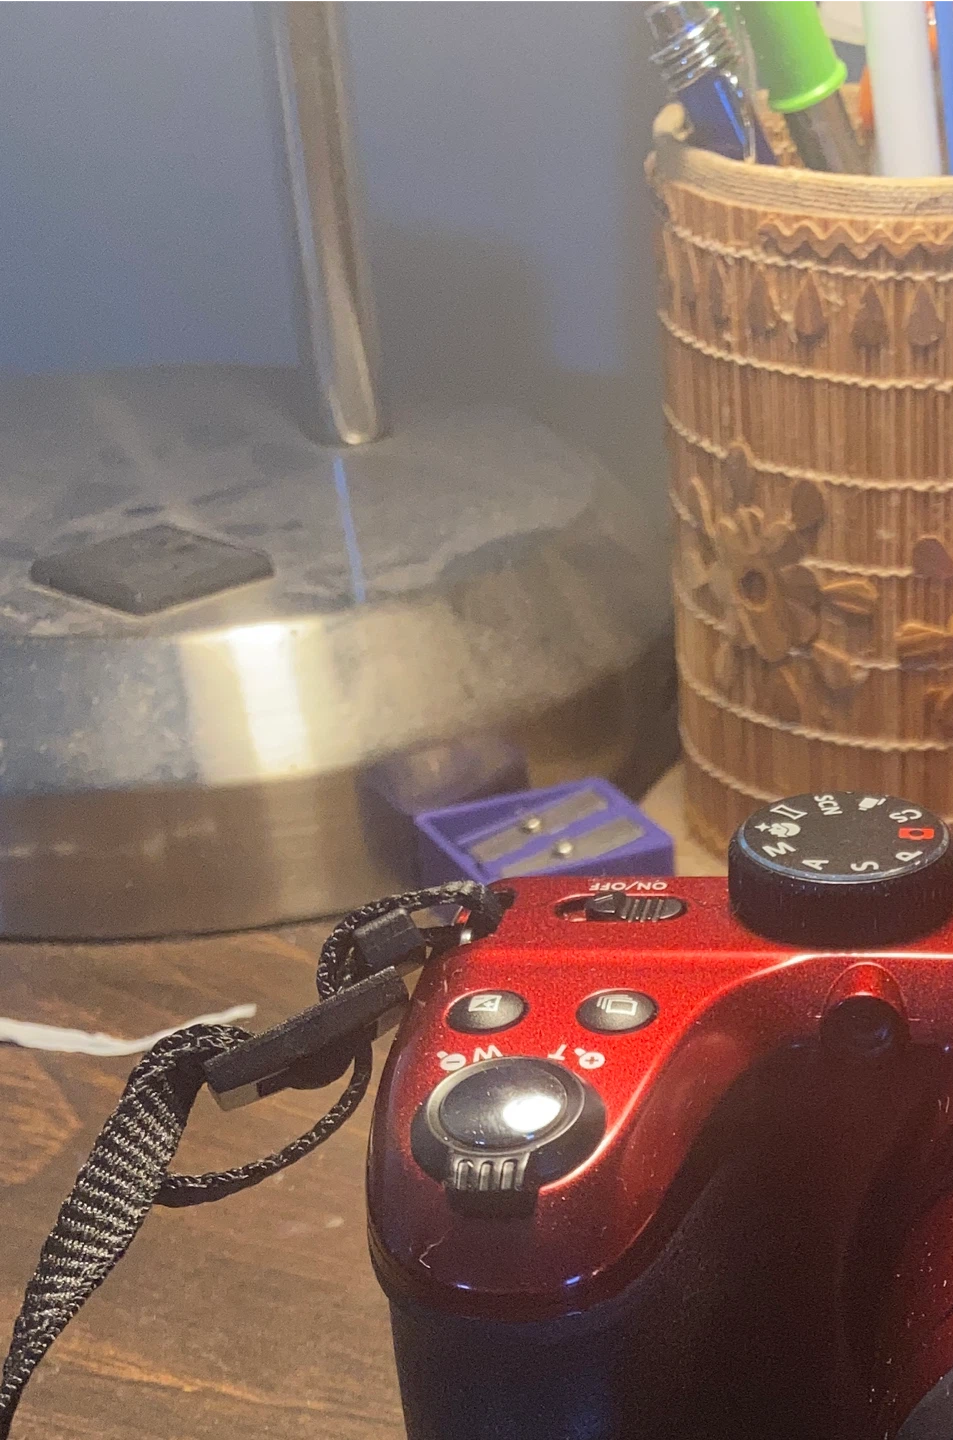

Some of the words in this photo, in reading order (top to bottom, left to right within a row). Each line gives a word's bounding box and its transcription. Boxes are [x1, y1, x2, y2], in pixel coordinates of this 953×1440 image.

[814, 794, 843, 817] SCN
[762, 841, 796, 858] M
[895, 849, 923, 862] P
[802, 858, 829, 871] A
[850, 860, 879, 872] S
[588, 881, 668, 891] ON/OFF
[472, 1044, 504, 1063] W
[547, 1043, 569, 1061] T
